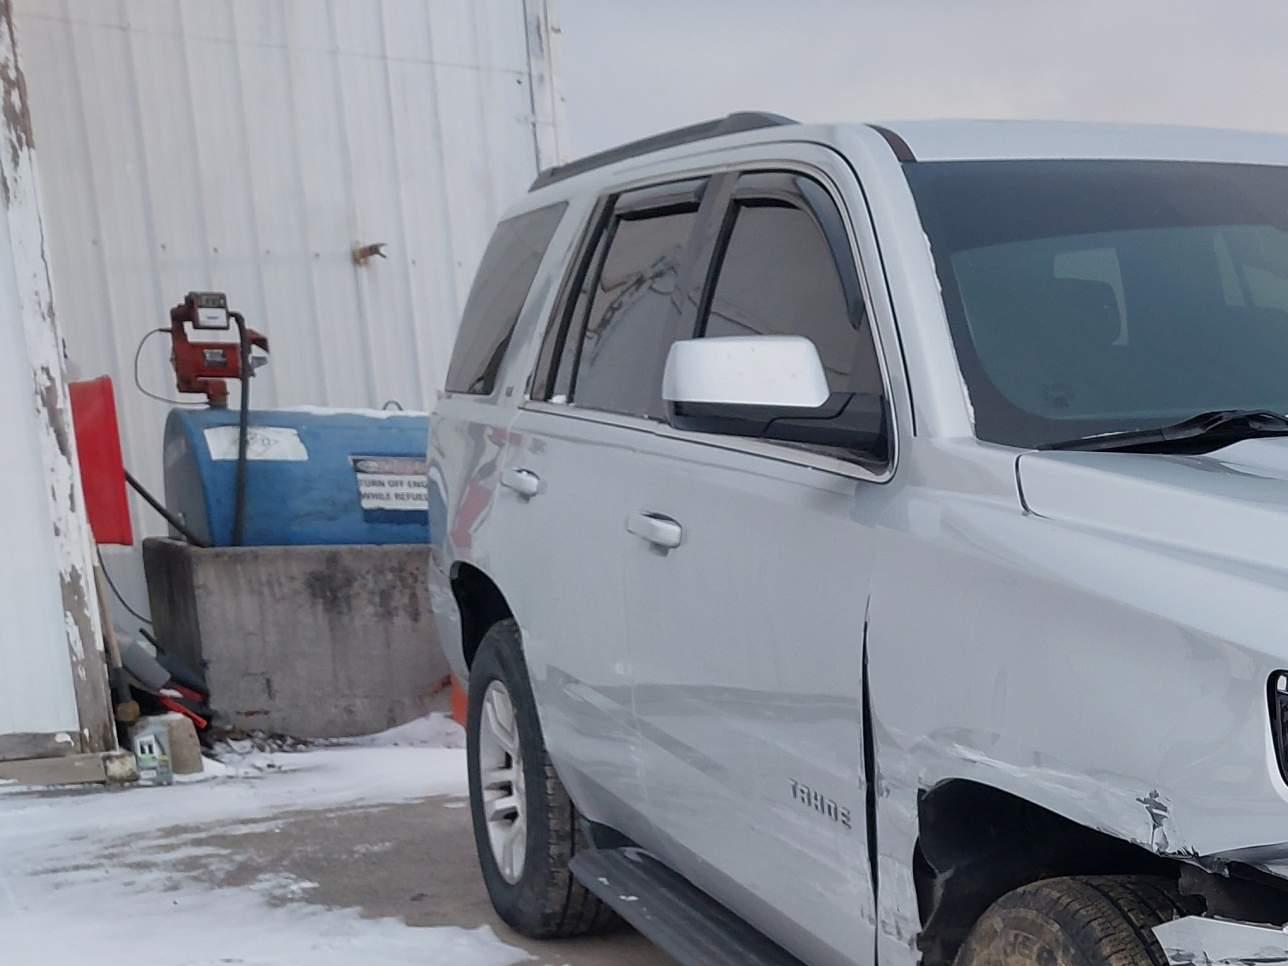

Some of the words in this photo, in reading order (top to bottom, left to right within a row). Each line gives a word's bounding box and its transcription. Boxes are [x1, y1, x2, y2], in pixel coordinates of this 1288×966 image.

[359, 479, 386, 488] TURN
[388, 479, 404, 488] OFF
[361, 491, 391, 501] WHILE
[787, 777, 853, 830] TAHOE
